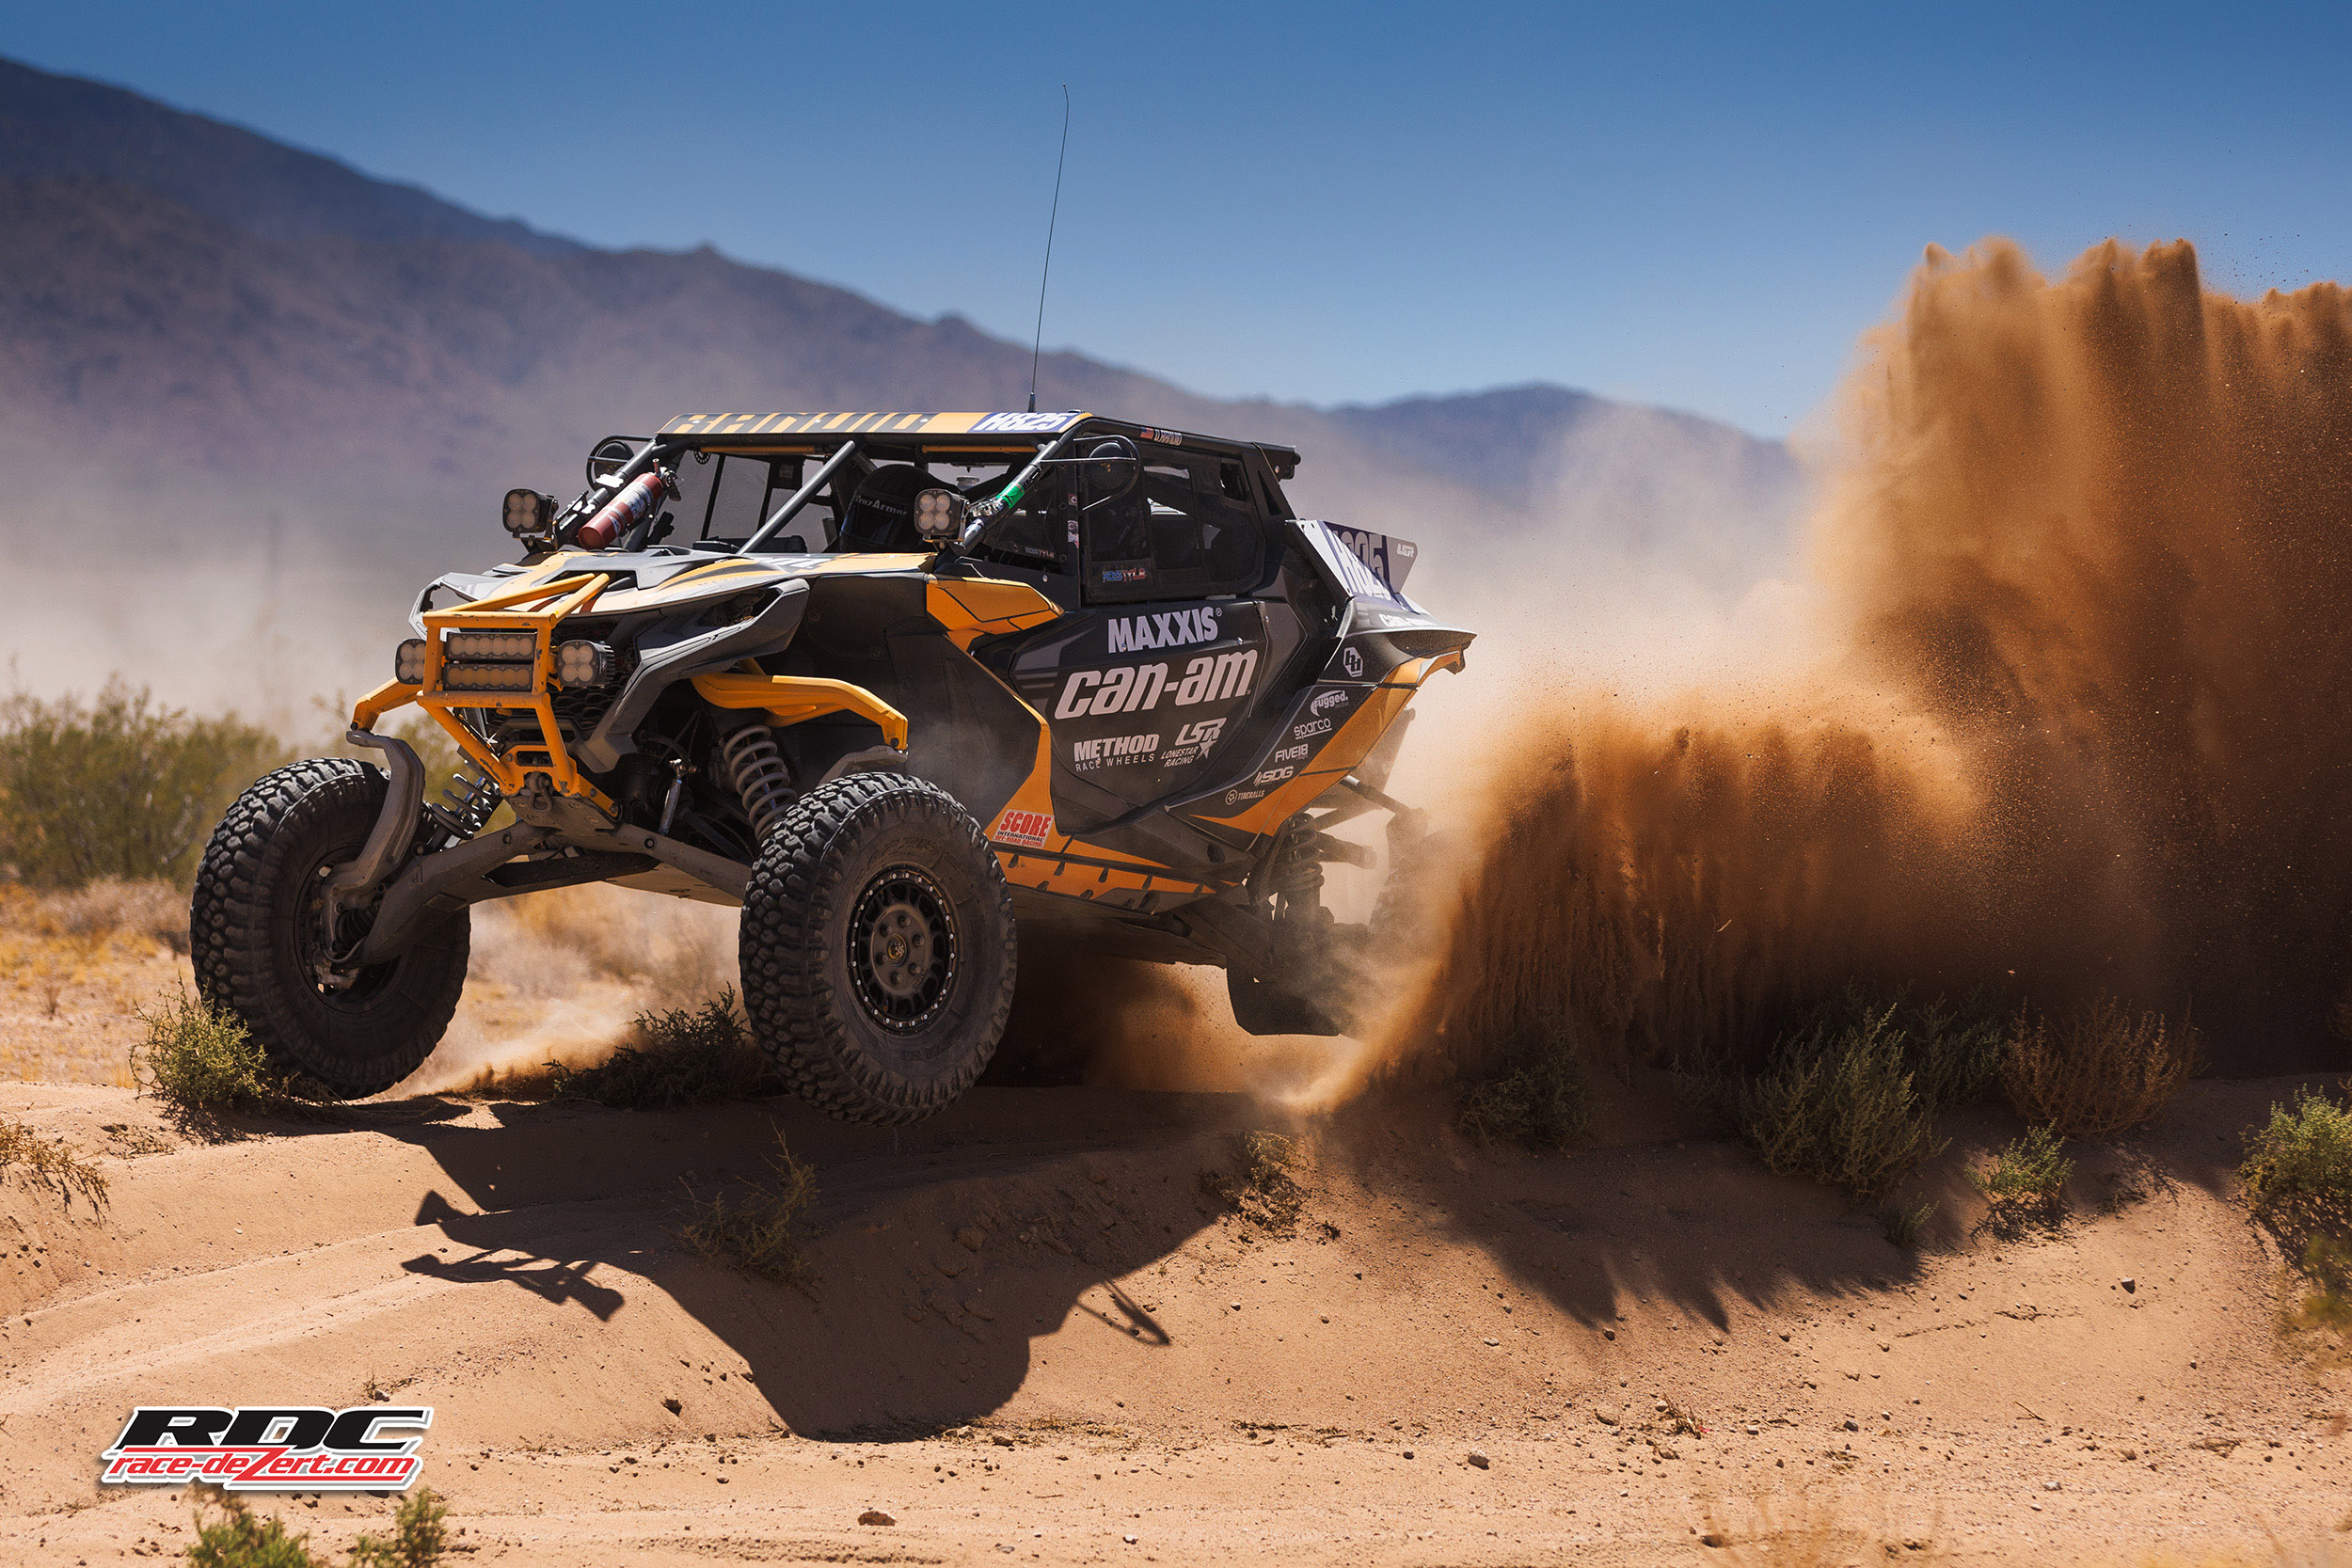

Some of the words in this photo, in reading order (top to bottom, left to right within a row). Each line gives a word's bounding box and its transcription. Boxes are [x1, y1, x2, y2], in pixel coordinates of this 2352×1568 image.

[973, 412, 1074, 431] H825
[1054, 649, 1258, 720] can-am
[1174, 718, 1228, 746] LSR
[1294, 718, 1331, 739] sparco
[1073, 734, 1160, 762] METHOD
[1160, 745, 1200, 760] LONESTAR
[1075, 758, 1101, 772] RACE
[1106, 753, 1155, 768] WHEELS
[1164, 755, 1195, 768] RACING
[1000, 812, 1052, 838] SCORE
[997, 831, 1043, 843] INTERNATIONAL
